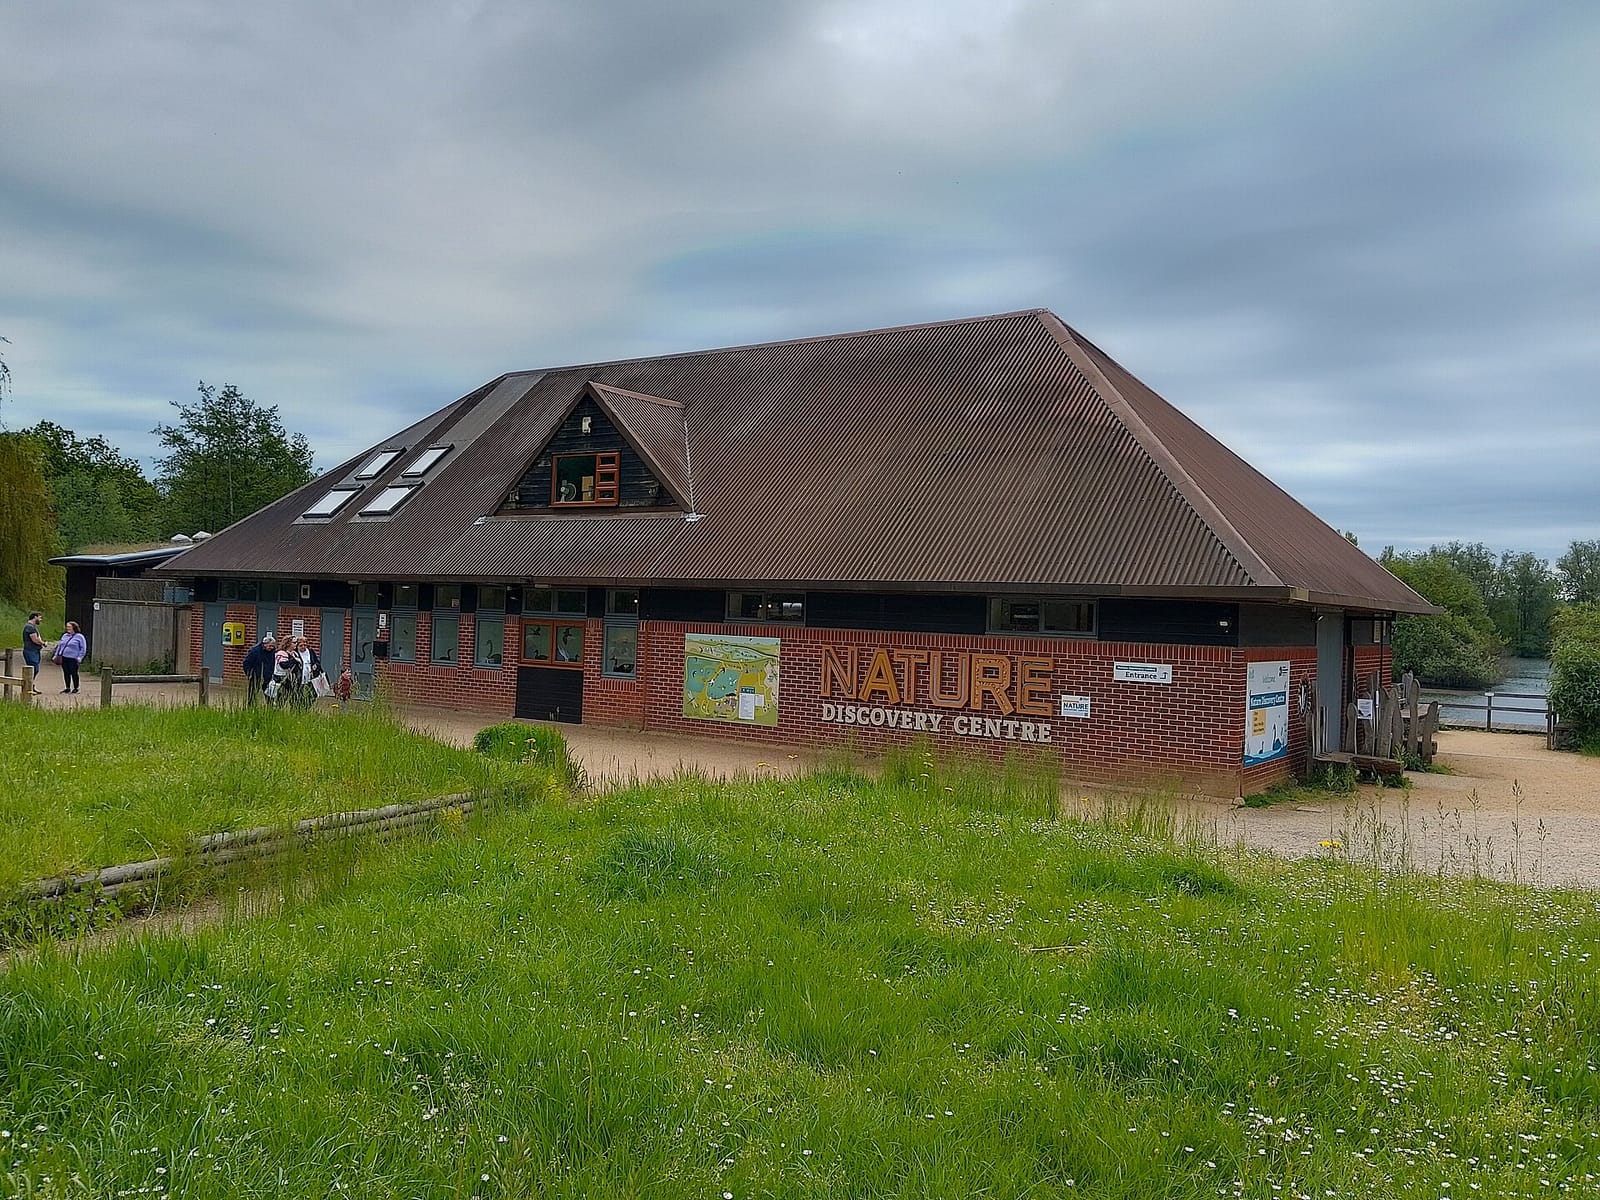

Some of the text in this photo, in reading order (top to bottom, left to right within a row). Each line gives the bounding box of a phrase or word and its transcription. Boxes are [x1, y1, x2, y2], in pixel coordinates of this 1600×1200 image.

[820, 645, 1054, 716] NATURE
[1125, 671, 1158, 680] Entrance
[1063, 702, 1089, 710] NATURE
[821, 703, 1051, 743] DISCOVERY CENTRE
